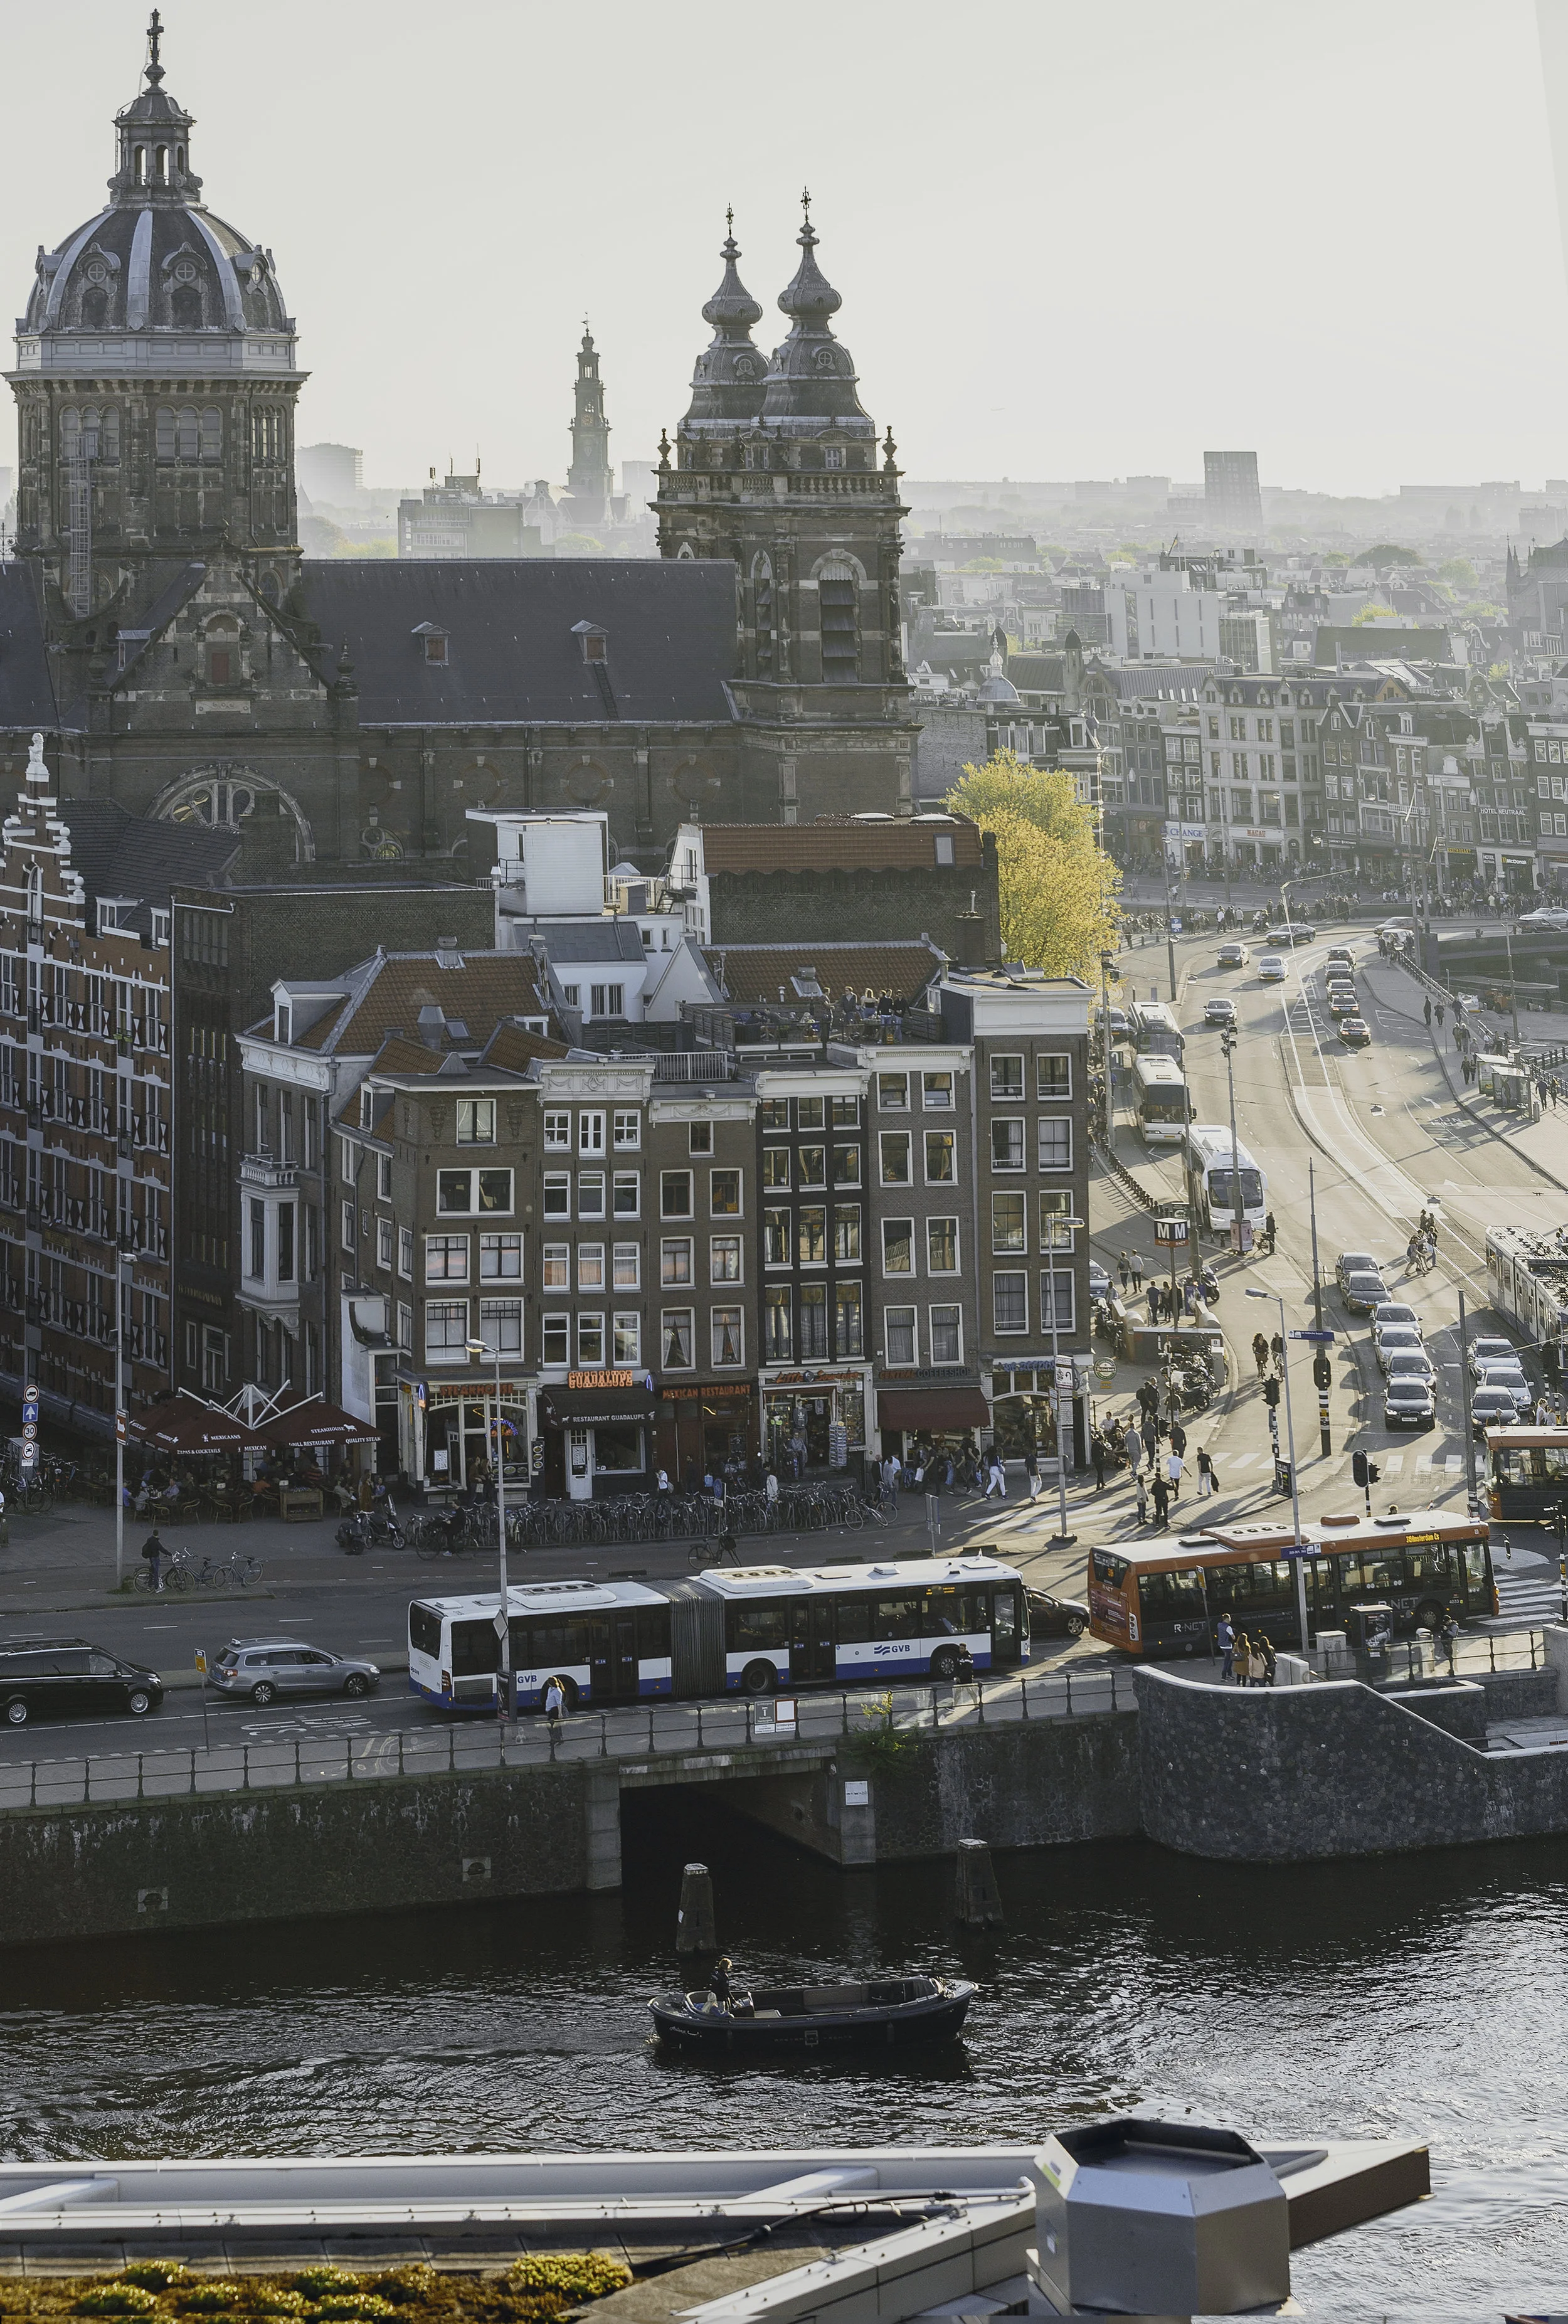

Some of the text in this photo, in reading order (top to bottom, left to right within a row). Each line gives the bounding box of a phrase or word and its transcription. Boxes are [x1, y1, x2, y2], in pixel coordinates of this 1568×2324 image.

[1157, 1223, 1170, 1239] M
[1175, 1223, 1185, 1239] M
[568, 1370, 633, 1389] GUADALUPE
[879, 1367, 971, 1379] CENTRAL COFFEESHOP
[662, 1384, 751, 1400] MEXICAN RESTAURANT
[891, 1645, 910, 1653] GVB
[517, 1675, 538, 1684] GVB
